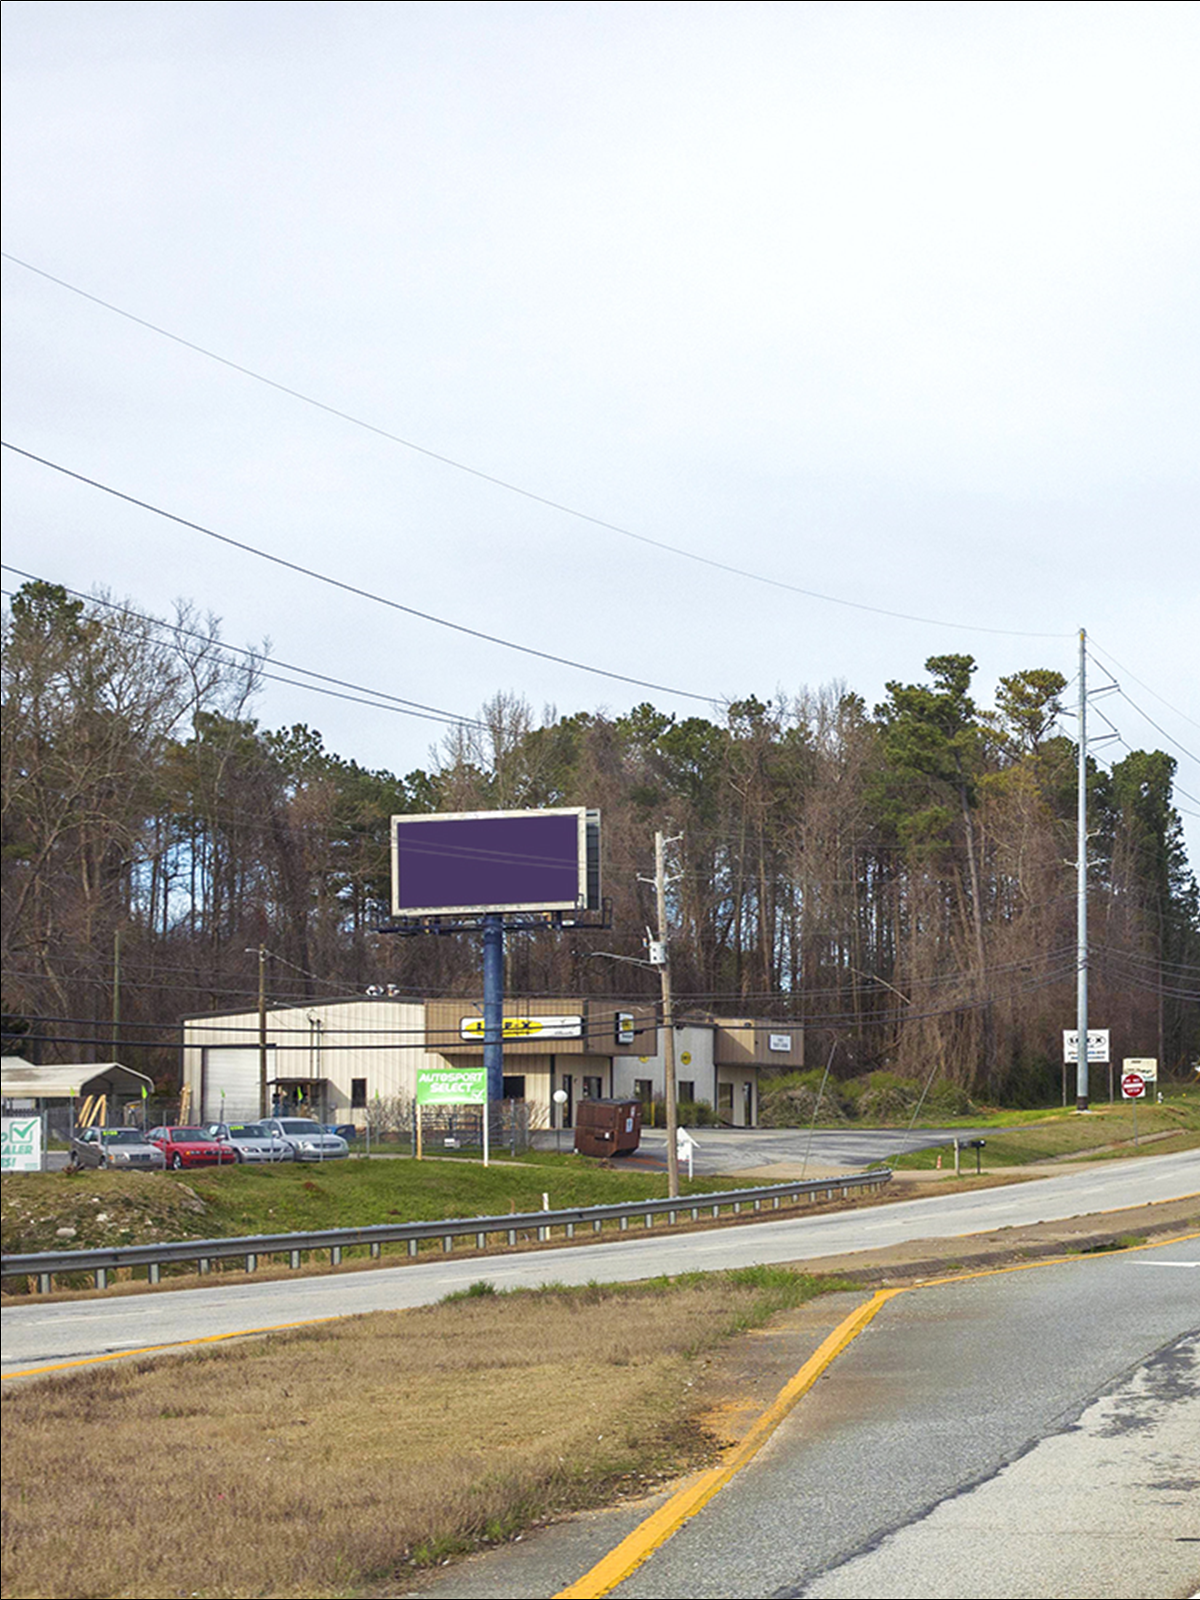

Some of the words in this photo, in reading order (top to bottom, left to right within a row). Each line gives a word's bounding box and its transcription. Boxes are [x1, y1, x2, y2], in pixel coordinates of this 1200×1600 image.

[419, 1073, 483, 1082] AUTOSPORT
[430, 1082, 473, 1092] SELECT
[1, 1145, 33, 1155] ALER
